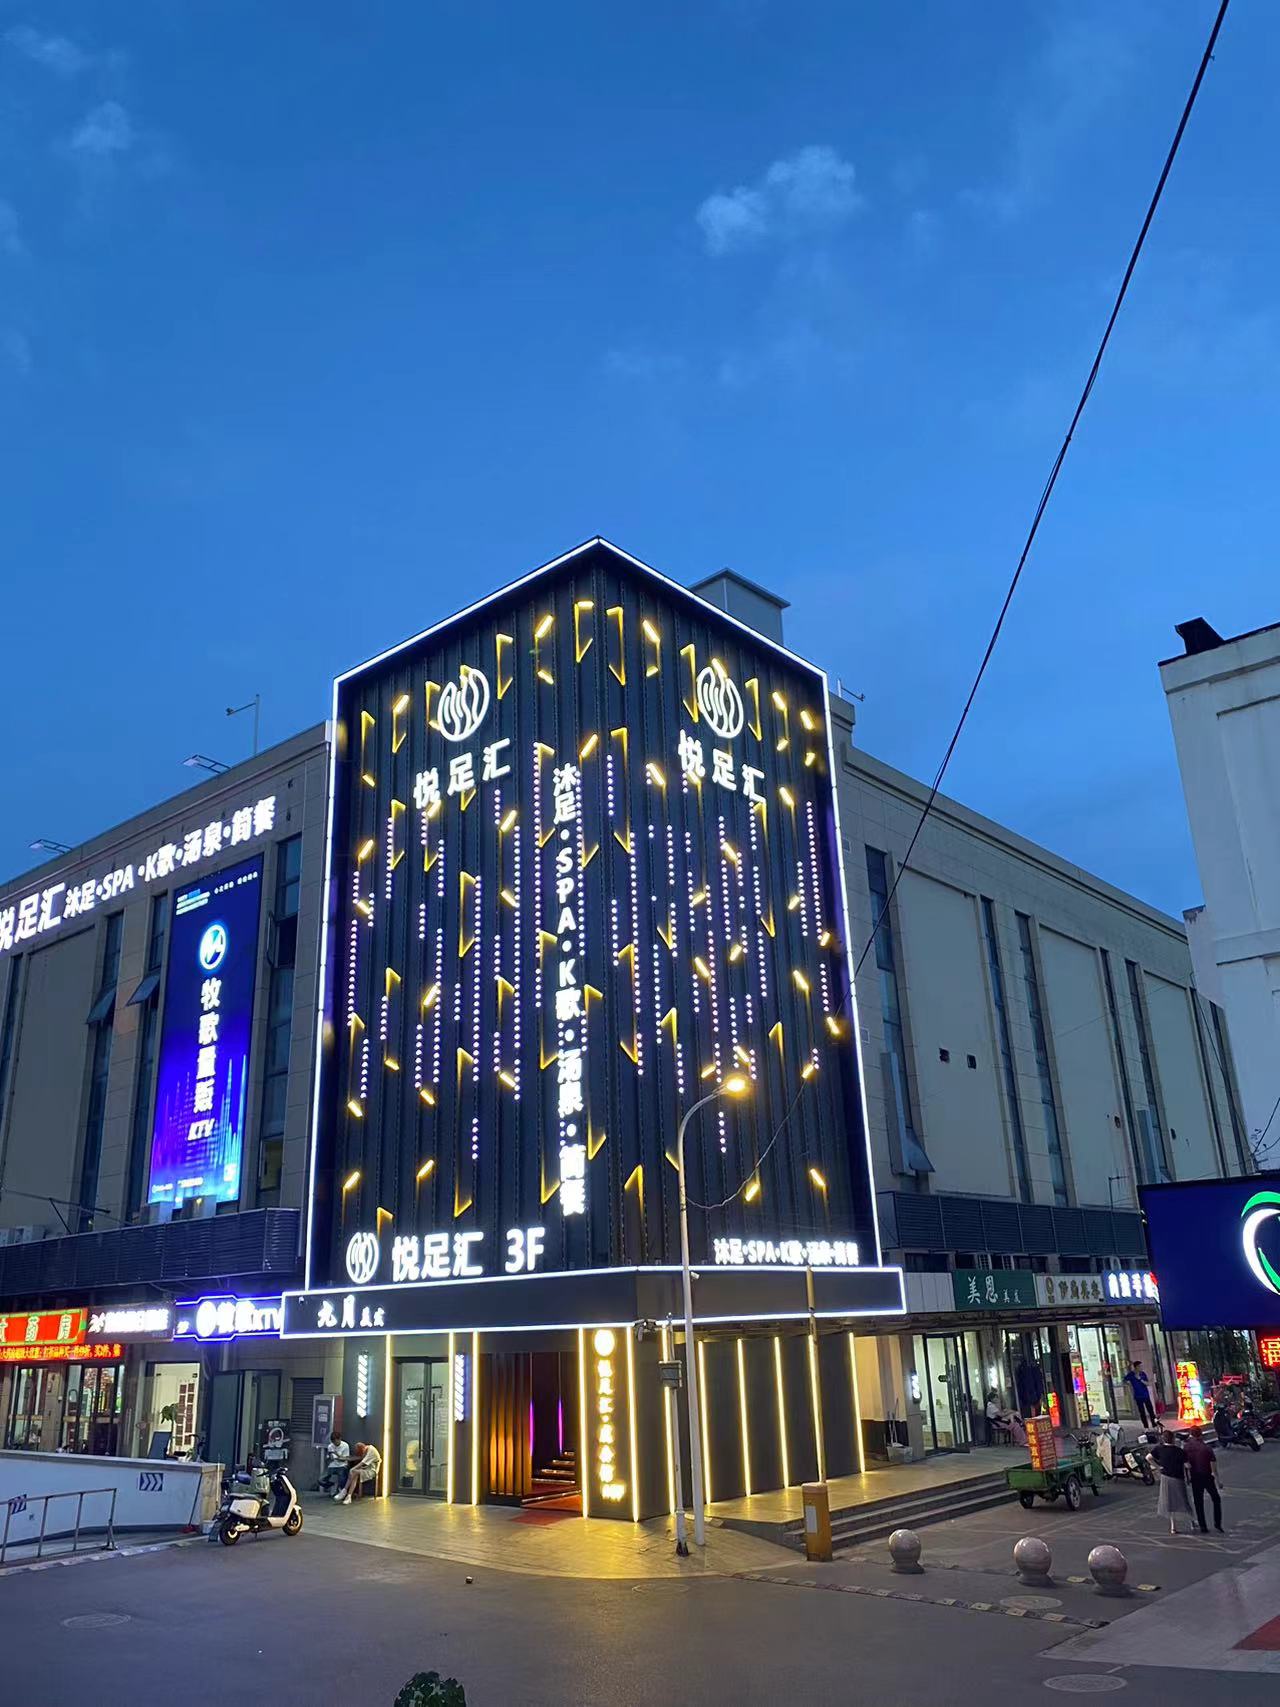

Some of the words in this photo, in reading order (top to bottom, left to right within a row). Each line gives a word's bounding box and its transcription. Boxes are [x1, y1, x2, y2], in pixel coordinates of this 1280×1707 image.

[413, 738, 511, 809] 悦足汇
[678, 729, 767, 804] 悦足汇
[188, 1118, 215, 1141] KTV
[392, 1231, 484, 1282] 悦足汇
[504, 1227, 546, 1274] 3F
